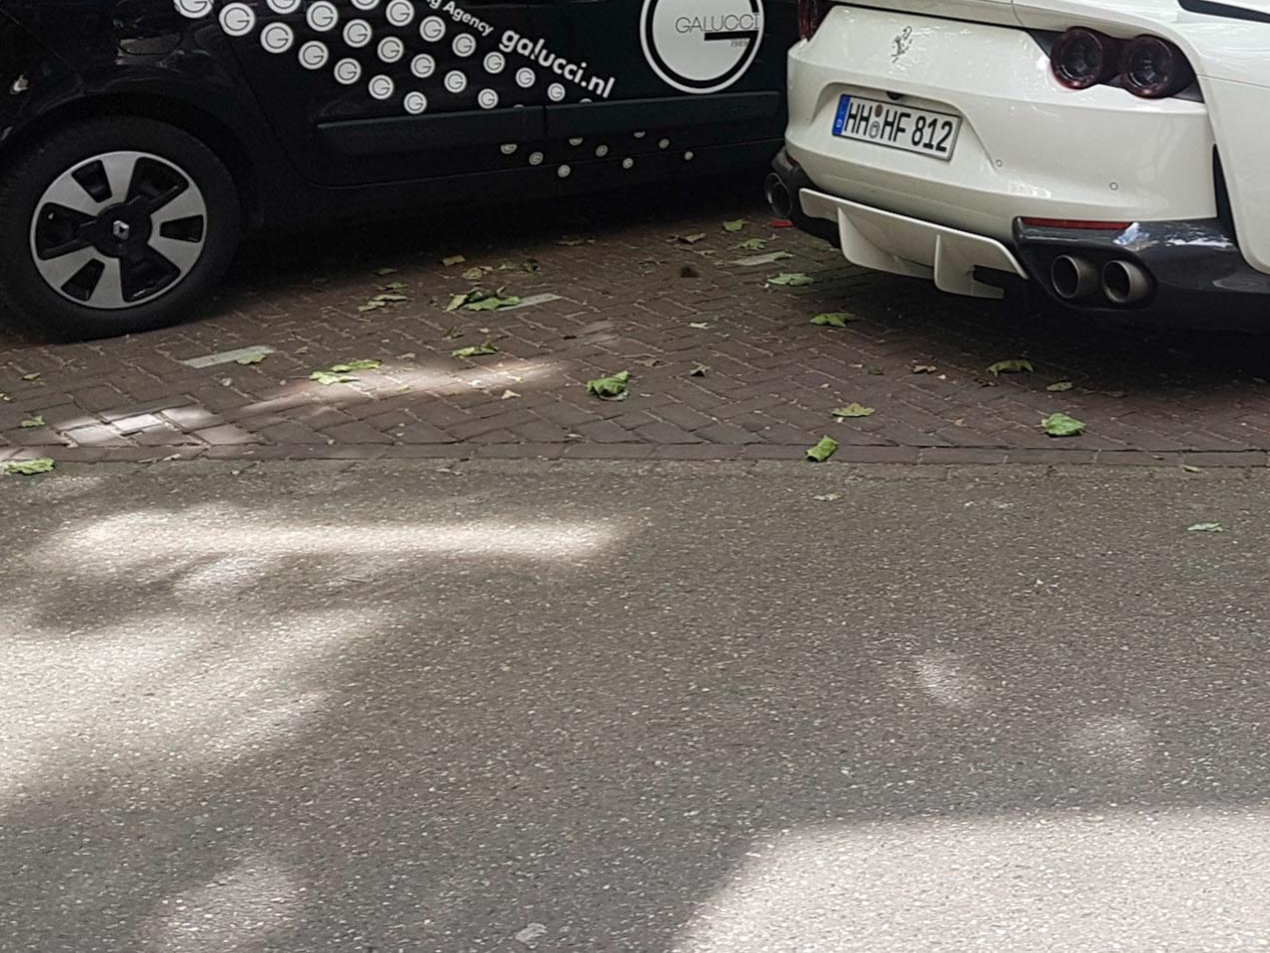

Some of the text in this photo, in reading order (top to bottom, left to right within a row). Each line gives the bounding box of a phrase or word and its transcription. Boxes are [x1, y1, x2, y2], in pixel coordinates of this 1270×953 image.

[442, 0, 494, 37] Agency
[675, 13, 760, 34] GALUCCI
[499, 30, 615, 98] galucci.nl
[844, 101, 953, 153] HH HF 812
